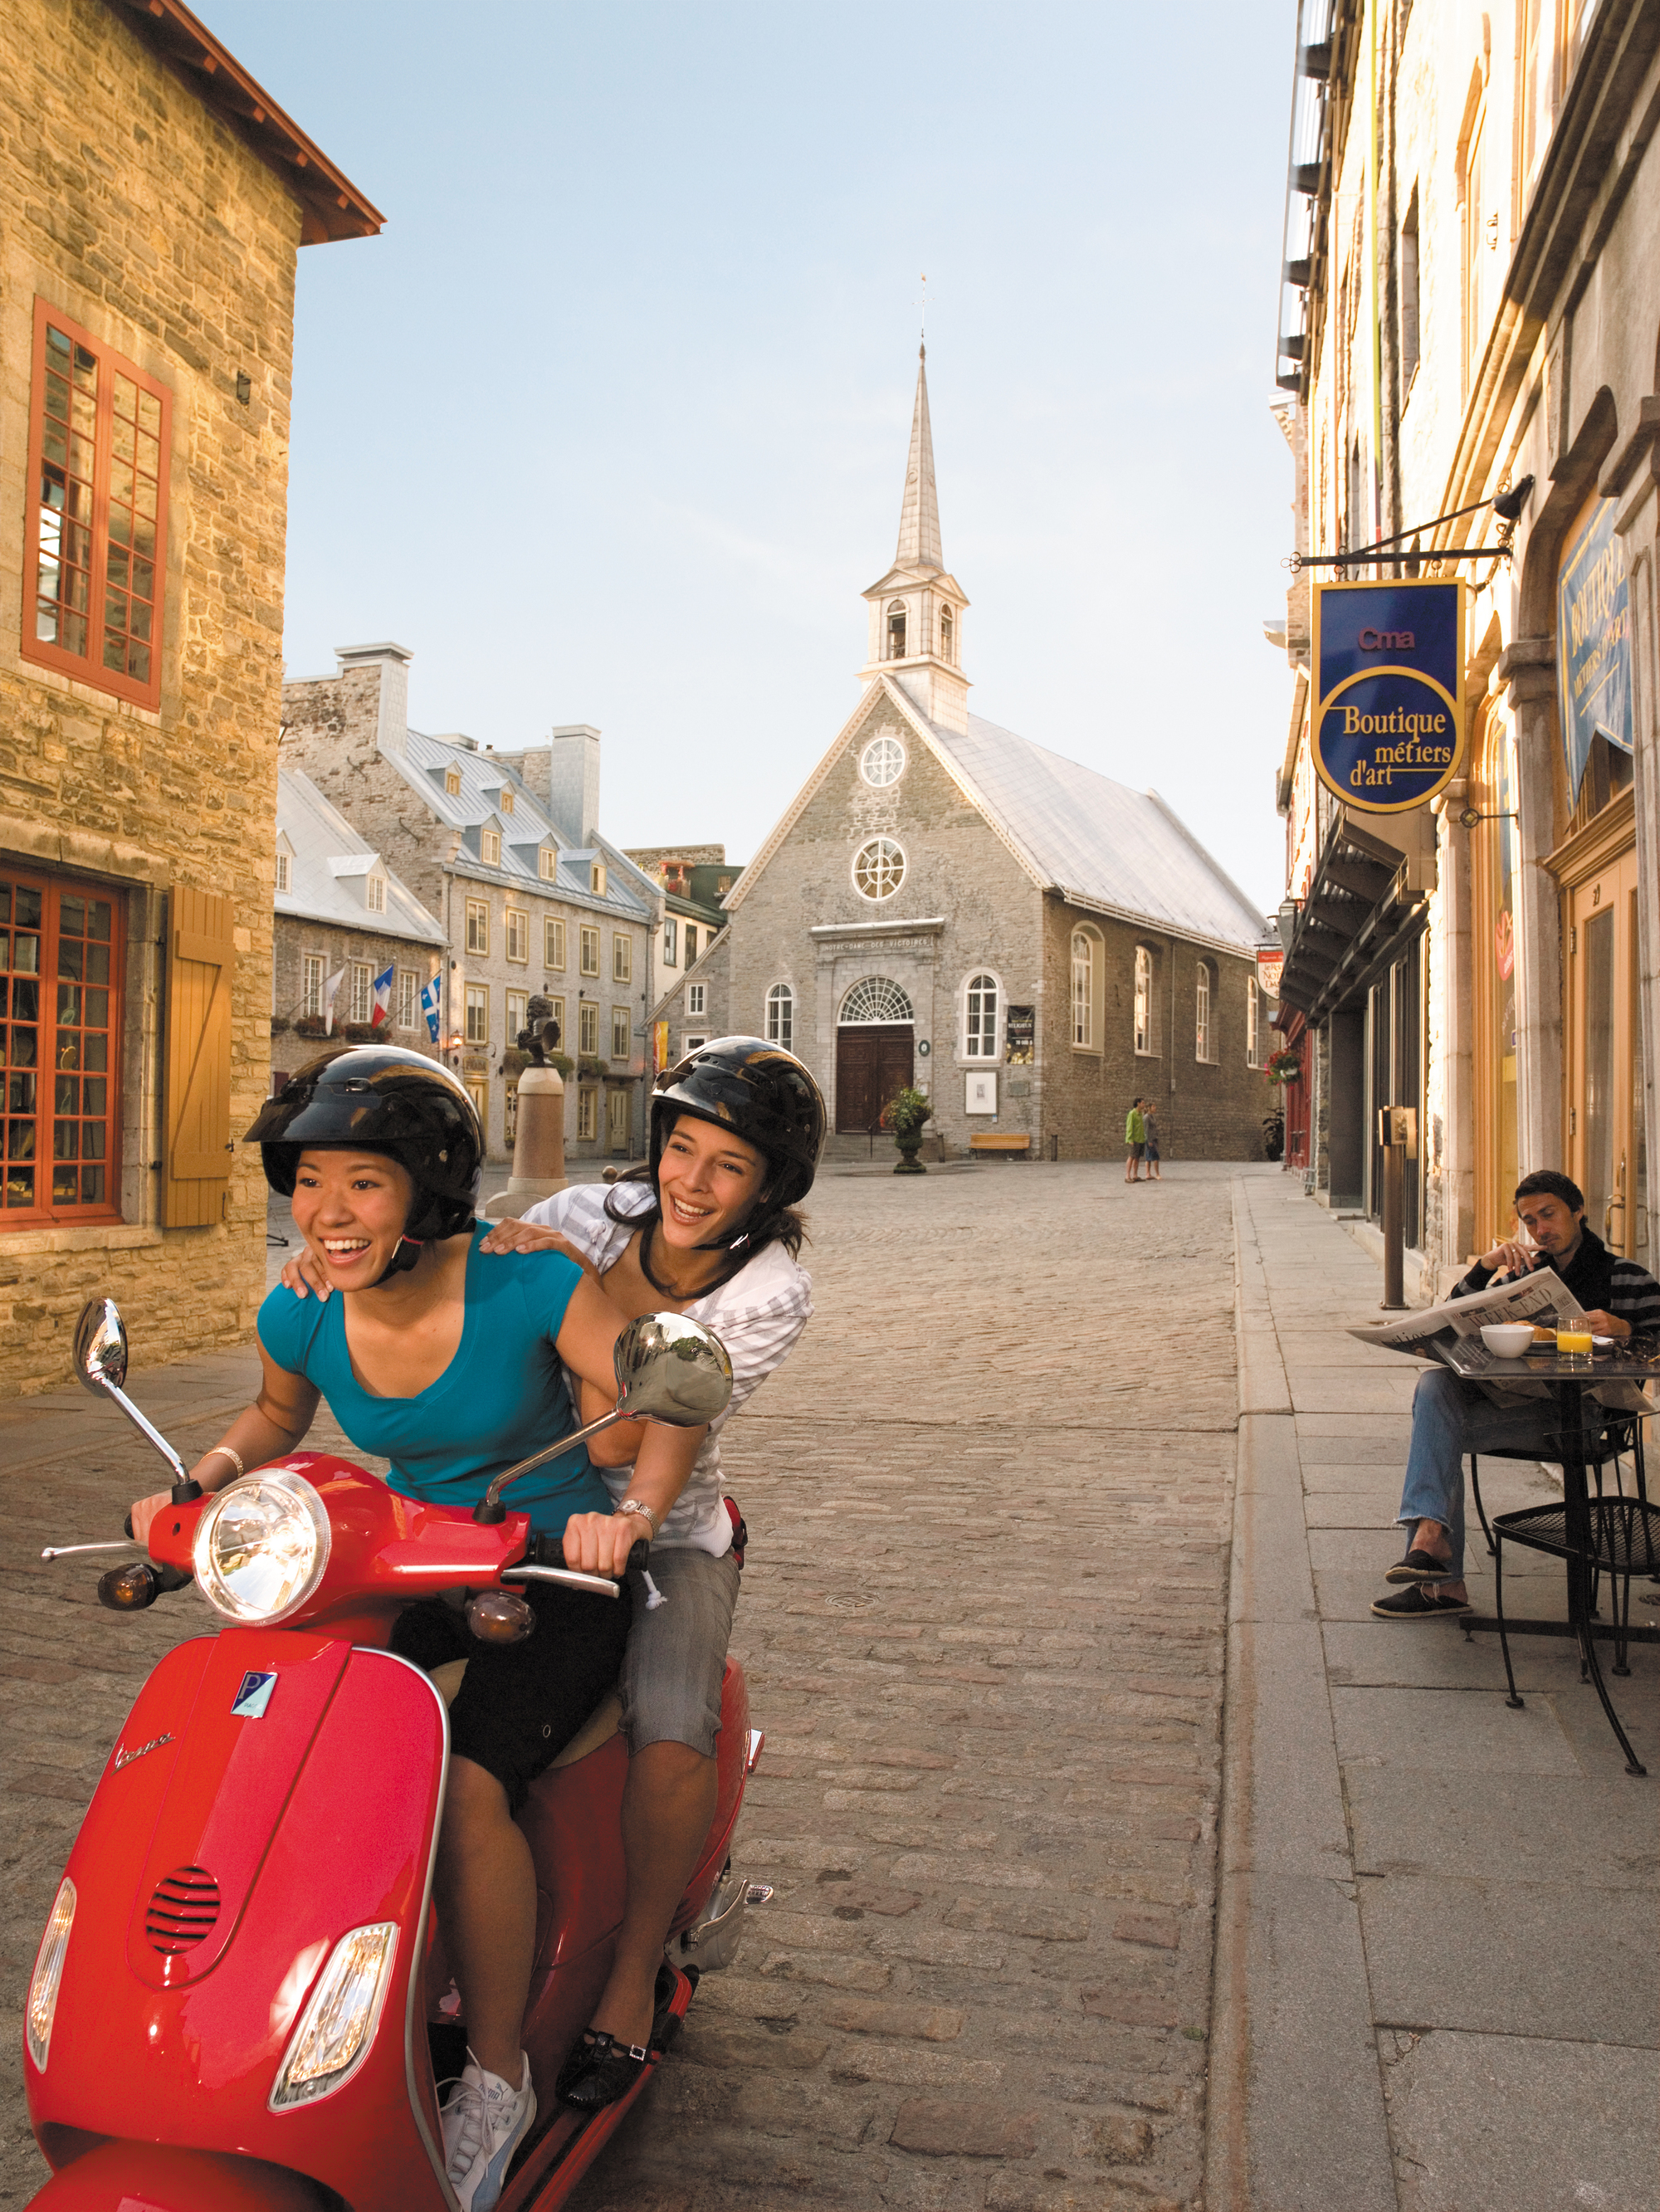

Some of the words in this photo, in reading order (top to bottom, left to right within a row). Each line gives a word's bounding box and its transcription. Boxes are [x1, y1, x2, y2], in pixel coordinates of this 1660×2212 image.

[1358, 627, 1415, 650] Cma
[1343, 706, 1446, 743] Boutique
[1374, 741, 1451, 764] métiers
[1350, 759, 1393, 786] d'art
[825, 942, 866, 951] NOTRE-DAME
[890, 939, 928, 947] VICTOIRES
[237, 1673, 261, 1700] P
[110, 1731, 177, 1777] Vespa
